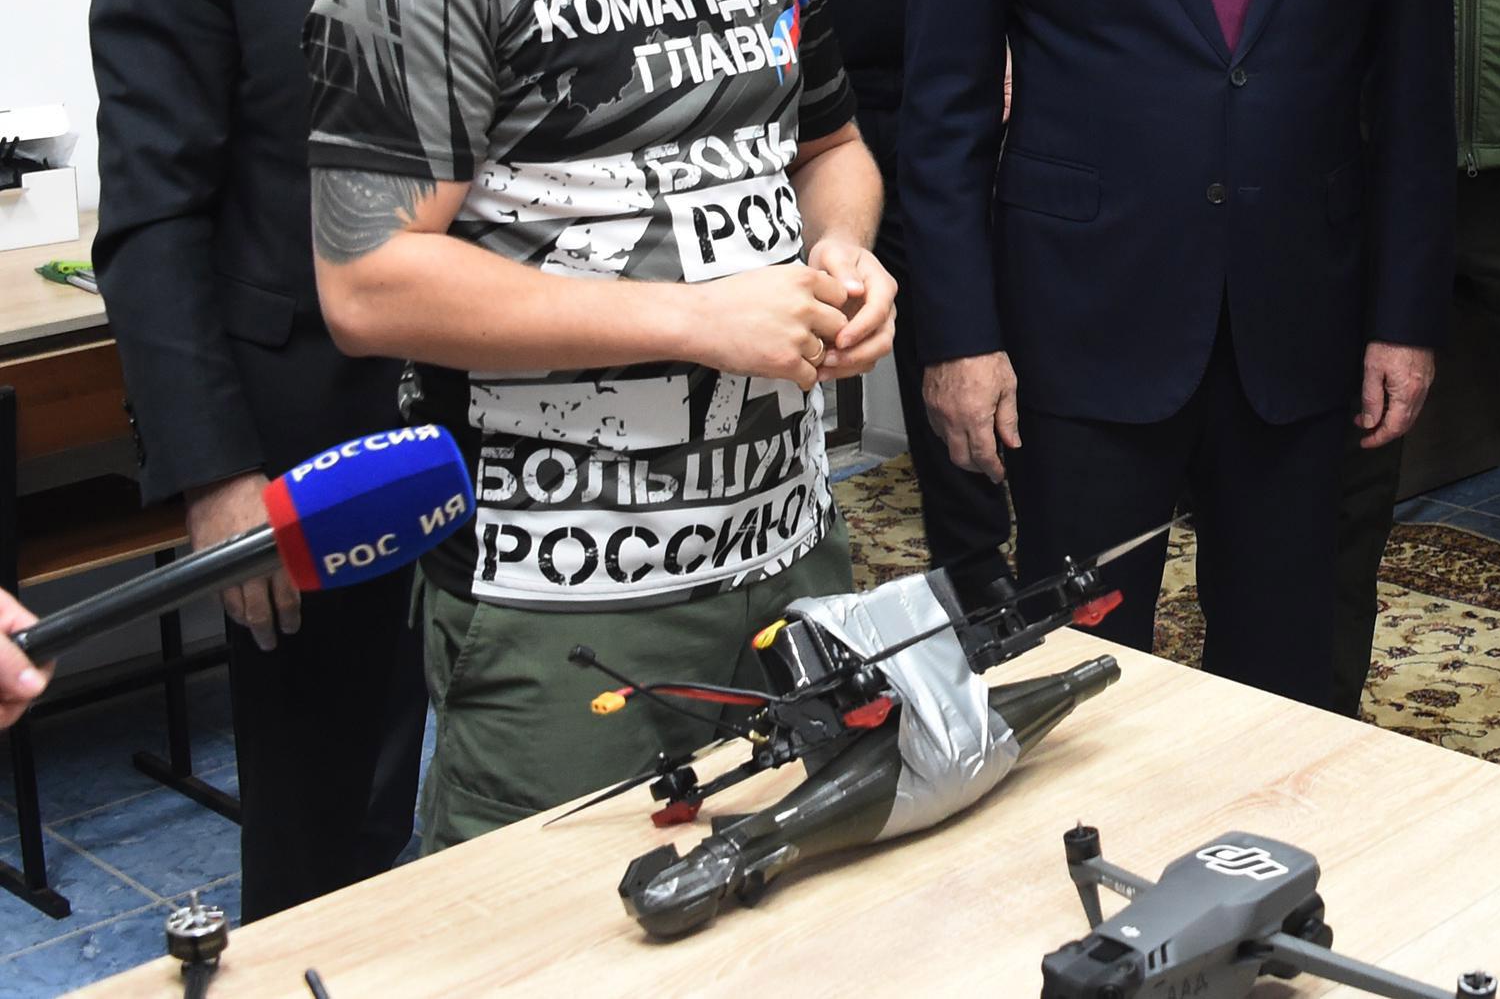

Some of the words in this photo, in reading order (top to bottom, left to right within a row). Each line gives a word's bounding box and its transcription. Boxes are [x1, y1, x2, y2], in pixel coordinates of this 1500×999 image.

[633, 23, 797, 93] ГЛАВЫ
[291, 423, 440, 483] РОССИЯ
[482, 483, 807, 586] РОССИЮ
